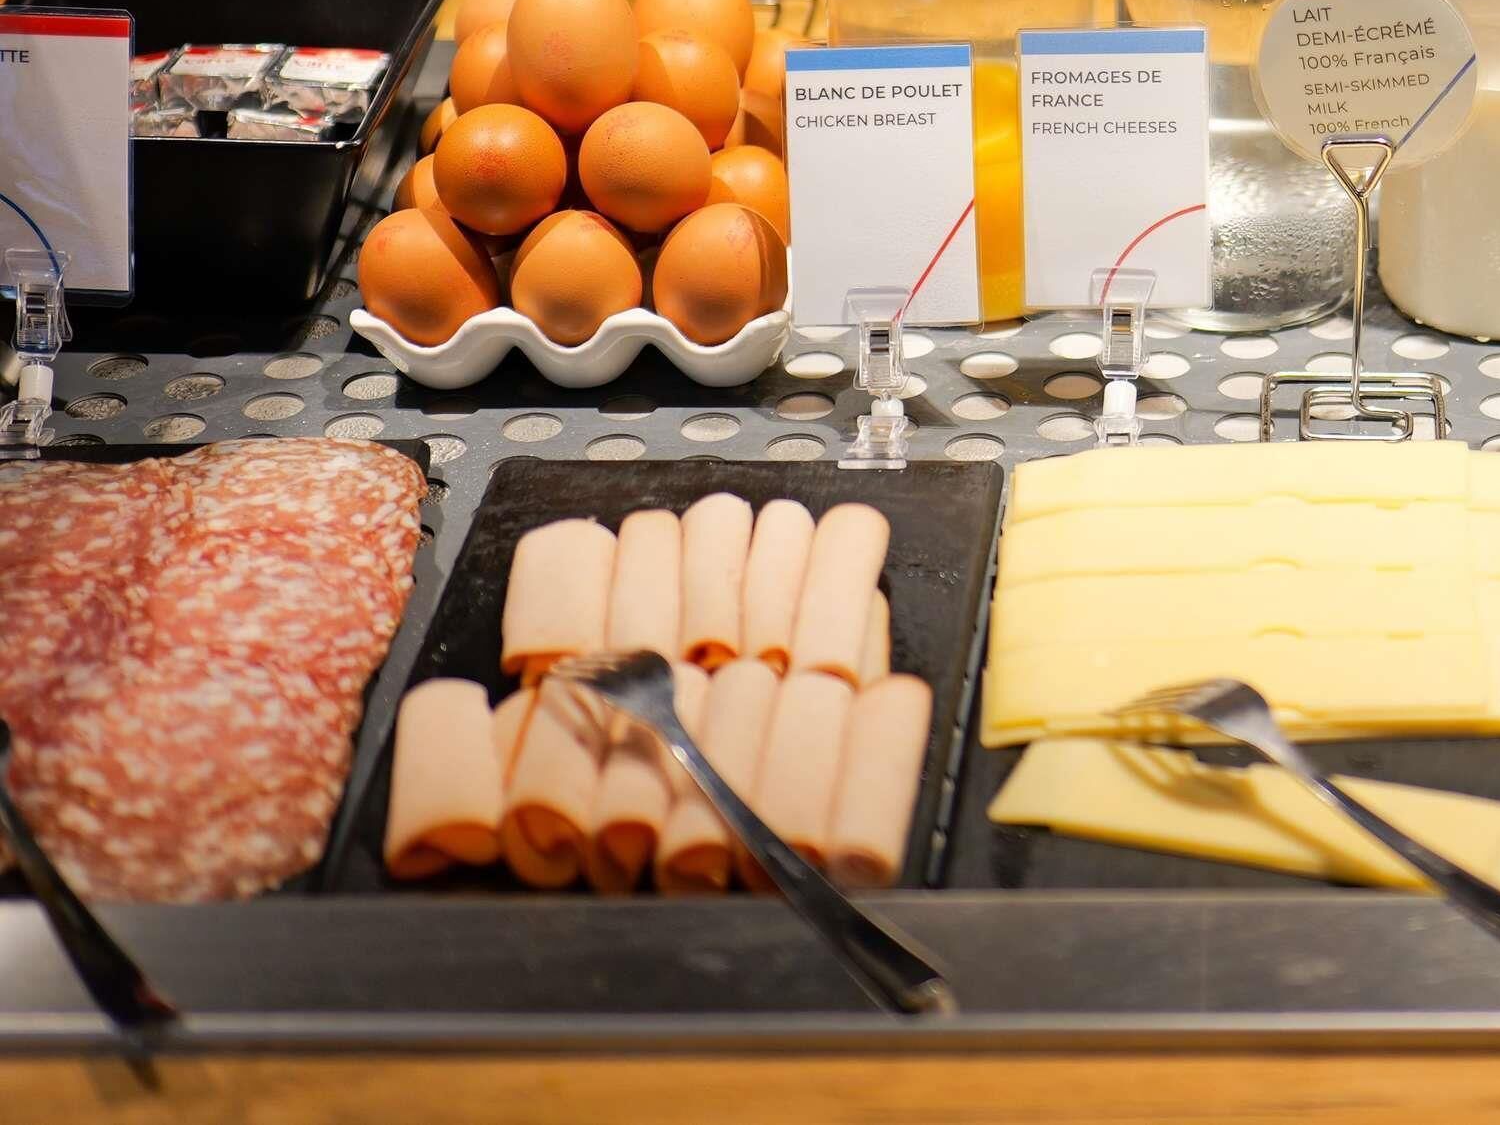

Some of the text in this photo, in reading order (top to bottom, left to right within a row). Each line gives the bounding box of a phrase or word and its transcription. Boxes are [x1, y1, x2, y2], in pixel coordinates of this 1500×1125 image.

[1293, 8, 1332, 23] LAIT
[1297, 18, 1436, 47] DEMI-ÉCRÉMÉ
[1299, 45, 1435, 70] 100% Français
[1032, 71, 1161, 84] FROMAGES DE
[1304, 74, 1430, 96] SEMI-SKIMMED
[796, 84, 962, 100] BLANC DE POULET
[1032, 95, 1104, 107] FRANCE
[1308, 101, 1348, 115] MILK
[796, 113, 936, 128] CHICKEN BREAST
[1033, 121, 1177, 134] FRENCH CHEESES
[1309, 115, 1409, 135] 100% French
